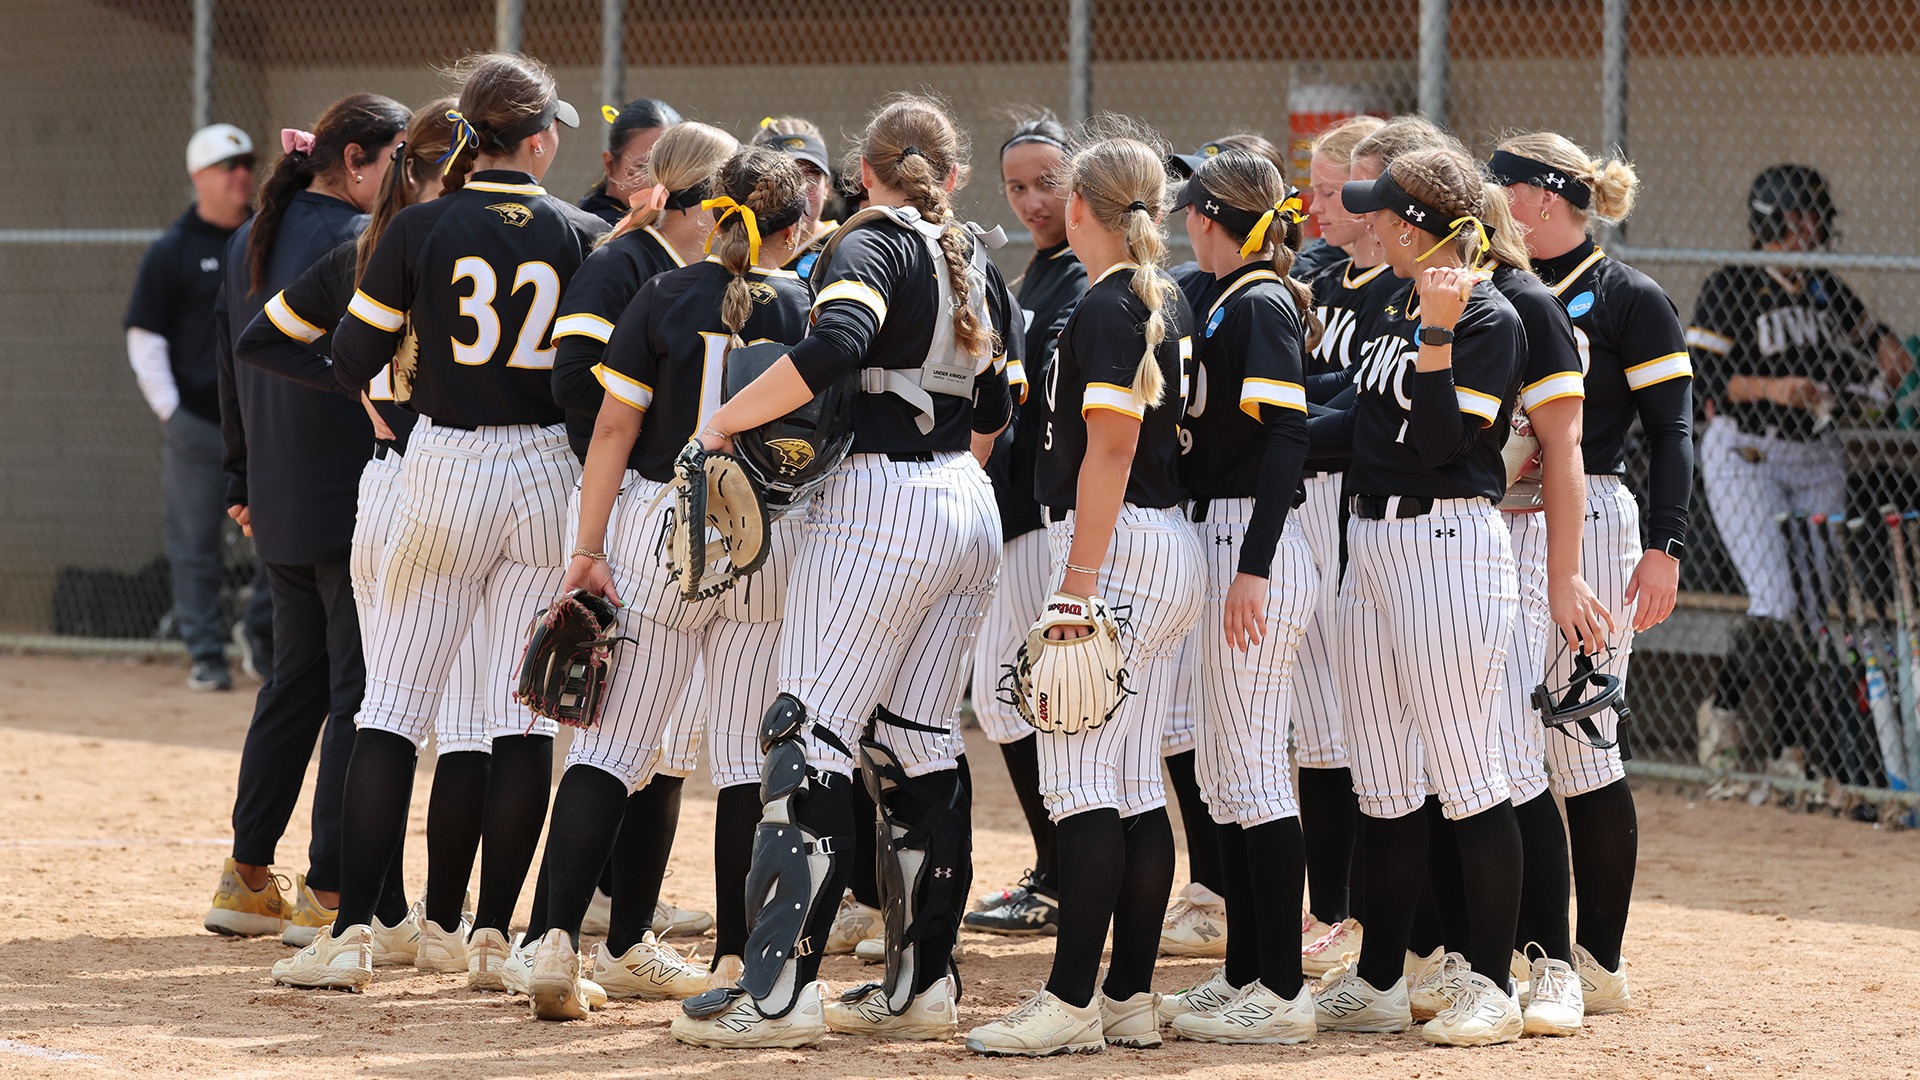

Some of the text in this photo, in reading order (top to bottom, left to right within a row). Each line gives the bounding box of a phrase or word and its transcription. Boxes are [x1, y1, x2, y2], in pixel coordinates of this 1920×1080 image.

[451, 256, 561, 370] 32
[933, 369, 949, 377] UNDER
[1044, 421, 1053, 451] 5
[1179, 428, 1194, 455] 9
[1047, 603, 1082, 616] Wilson
[1039, 691, 1048, 723] A2000
